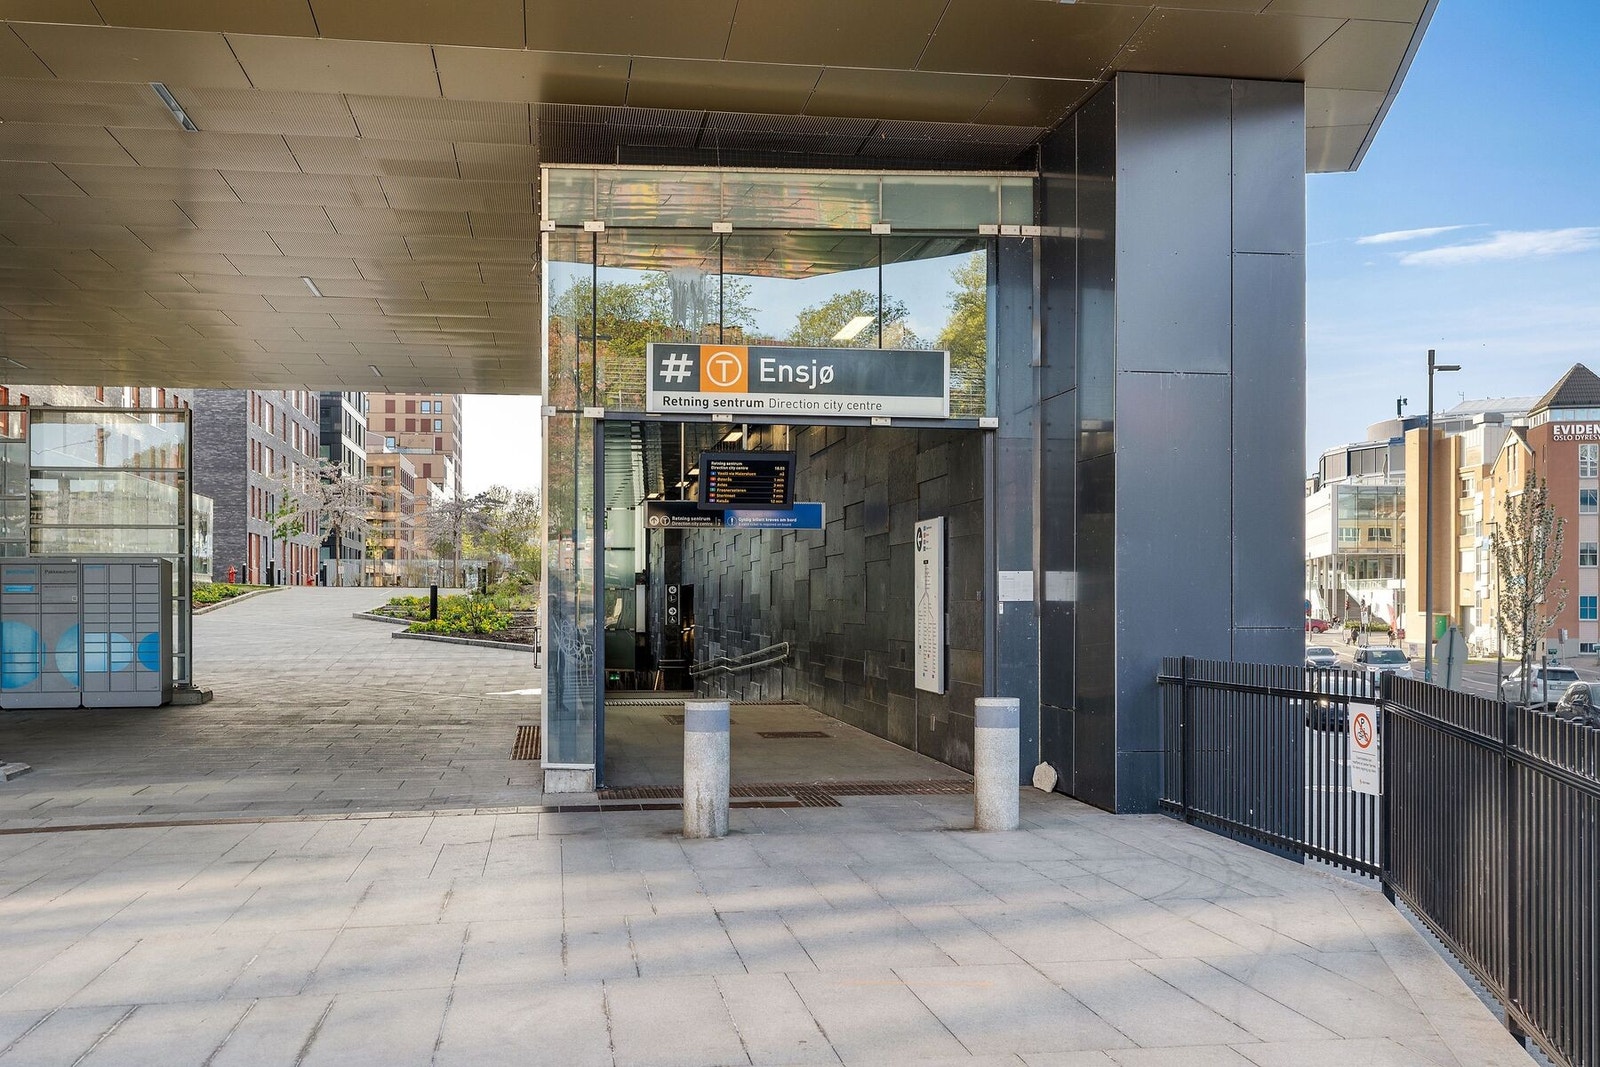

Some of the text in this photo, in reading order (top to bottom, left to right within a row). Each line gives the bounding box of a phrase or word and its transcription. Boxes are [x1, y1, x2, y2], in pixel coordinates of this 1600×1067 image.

[760, 358, 834, 389] Ensjø
[663, 396, 882, 412] Retning sentrum Direction city centre
[1554, 424, 1600, 434] EVIDEN
